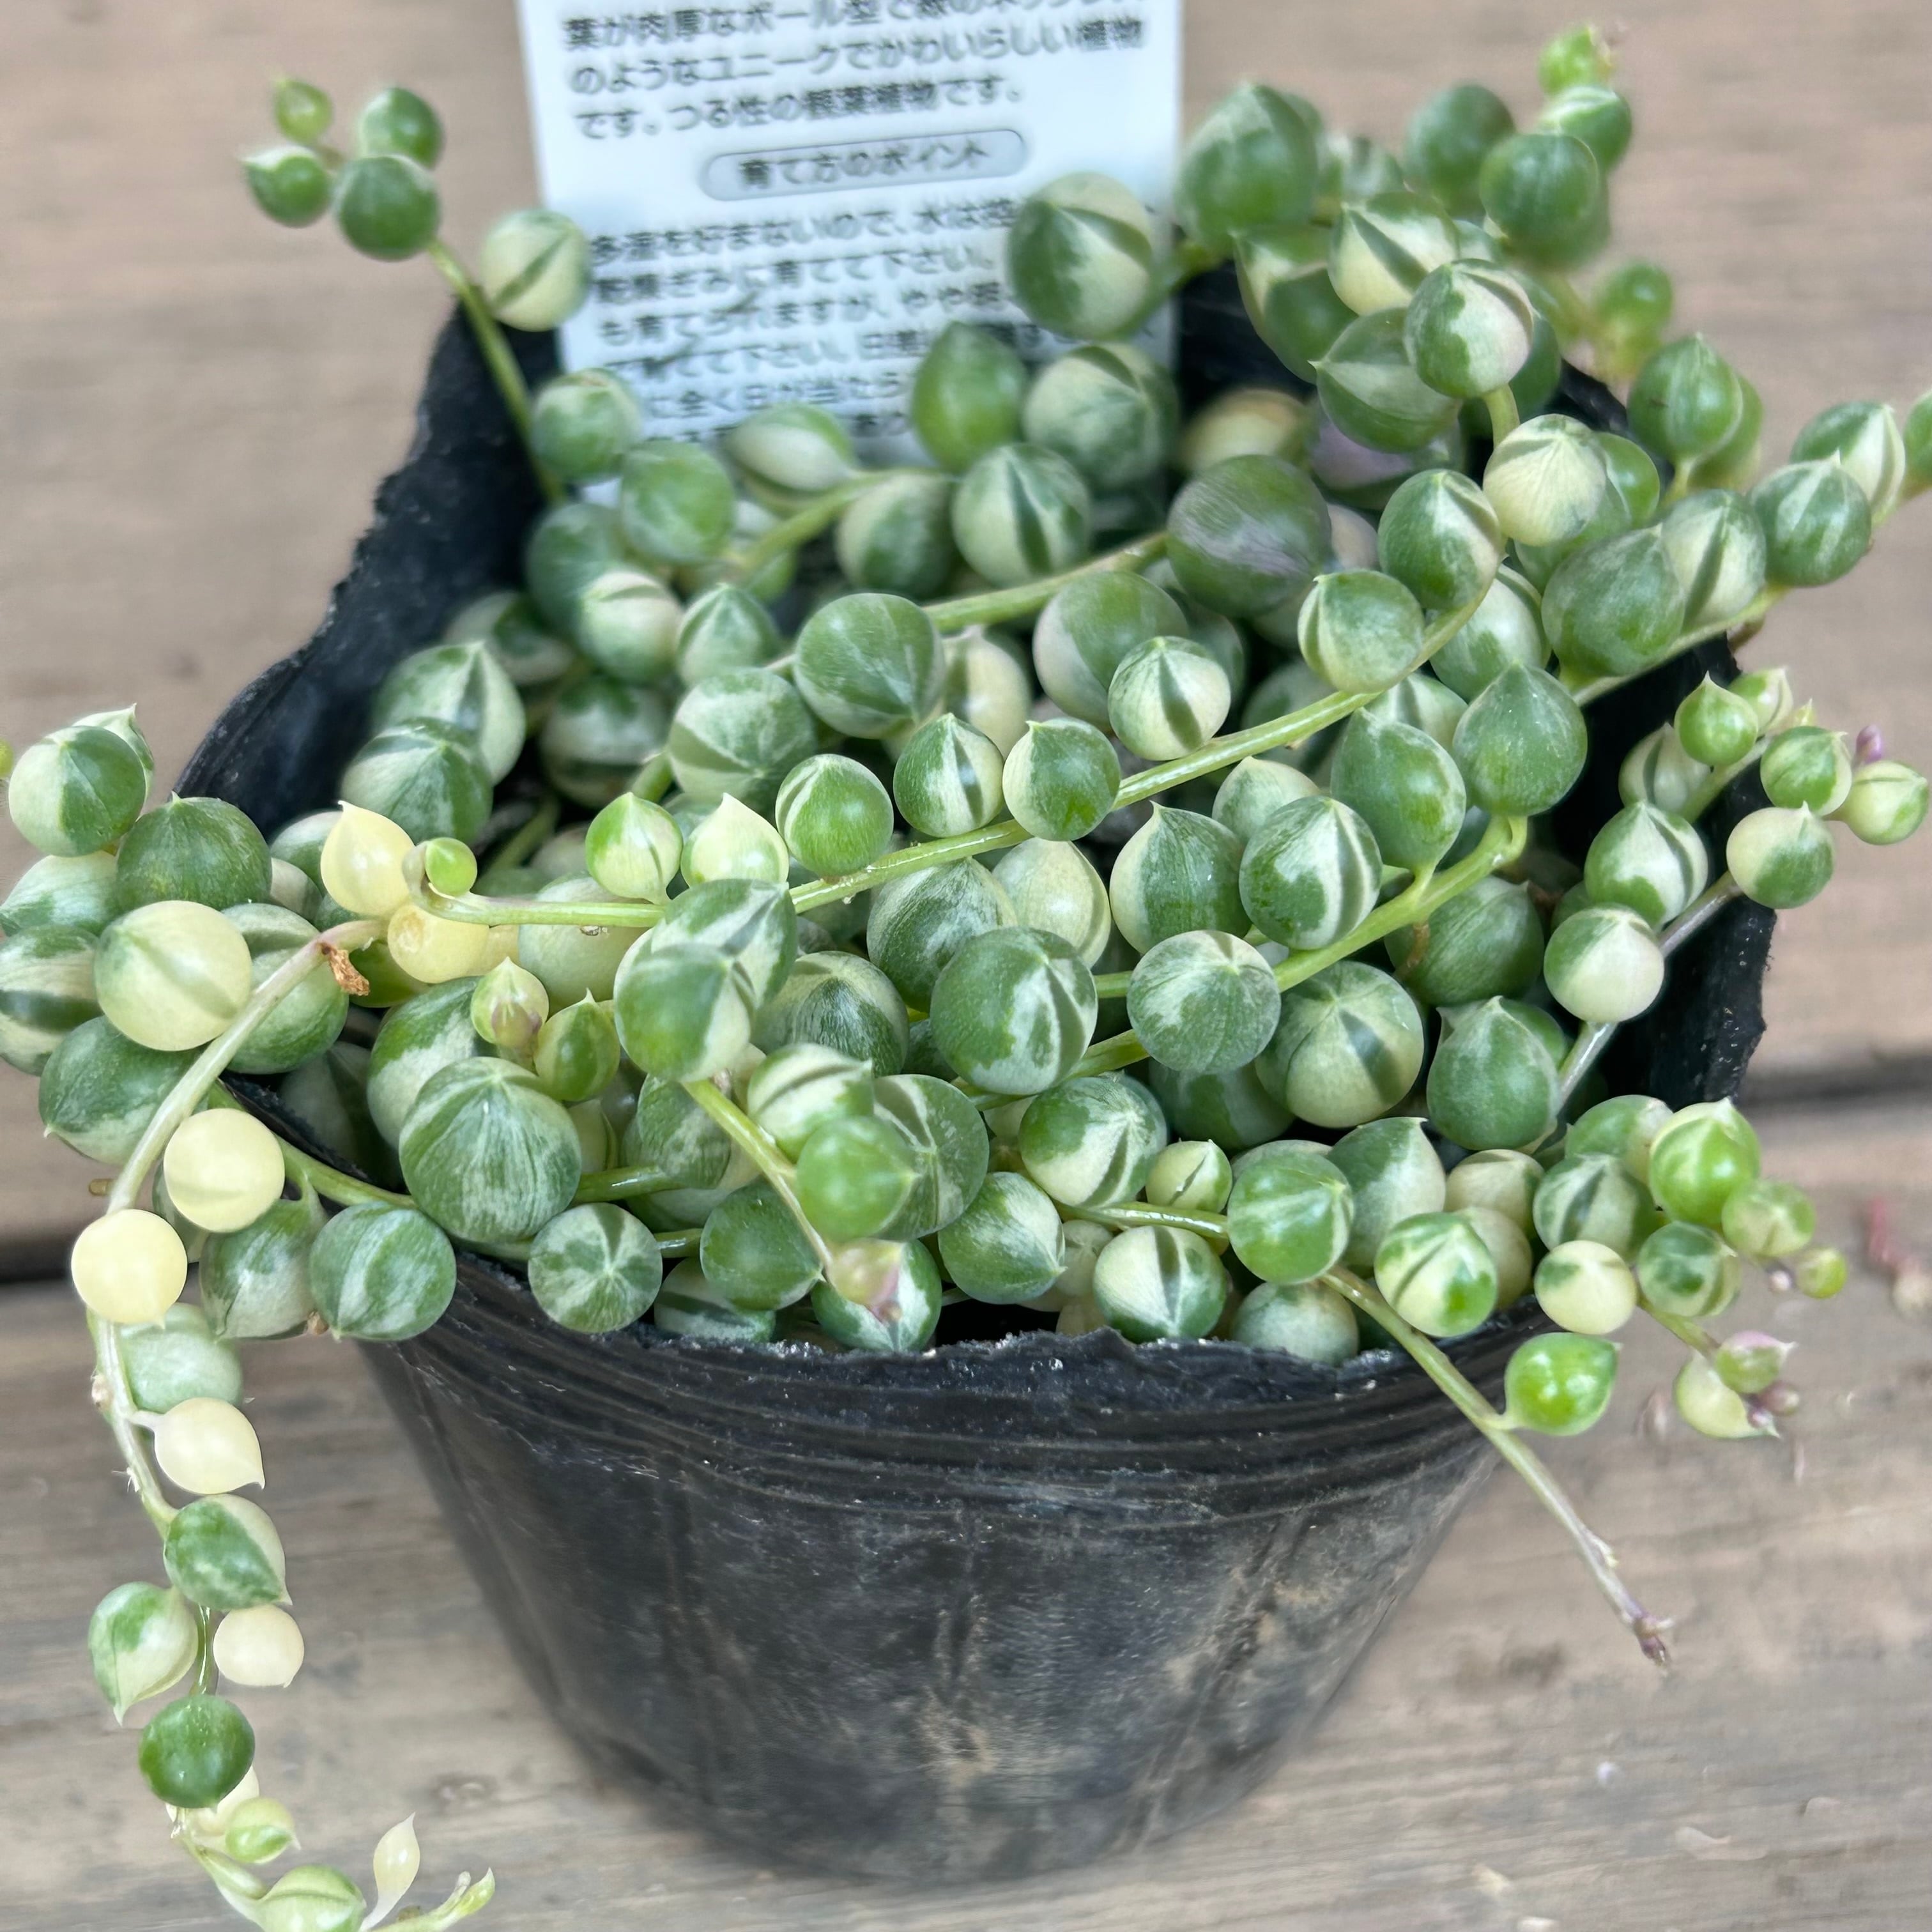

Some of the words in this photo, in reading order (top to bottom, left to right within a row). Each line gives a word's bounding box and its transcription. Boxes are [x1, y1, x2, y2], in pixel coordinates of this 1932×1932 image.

[739, 139, 989, 188] 育て方のポイント
